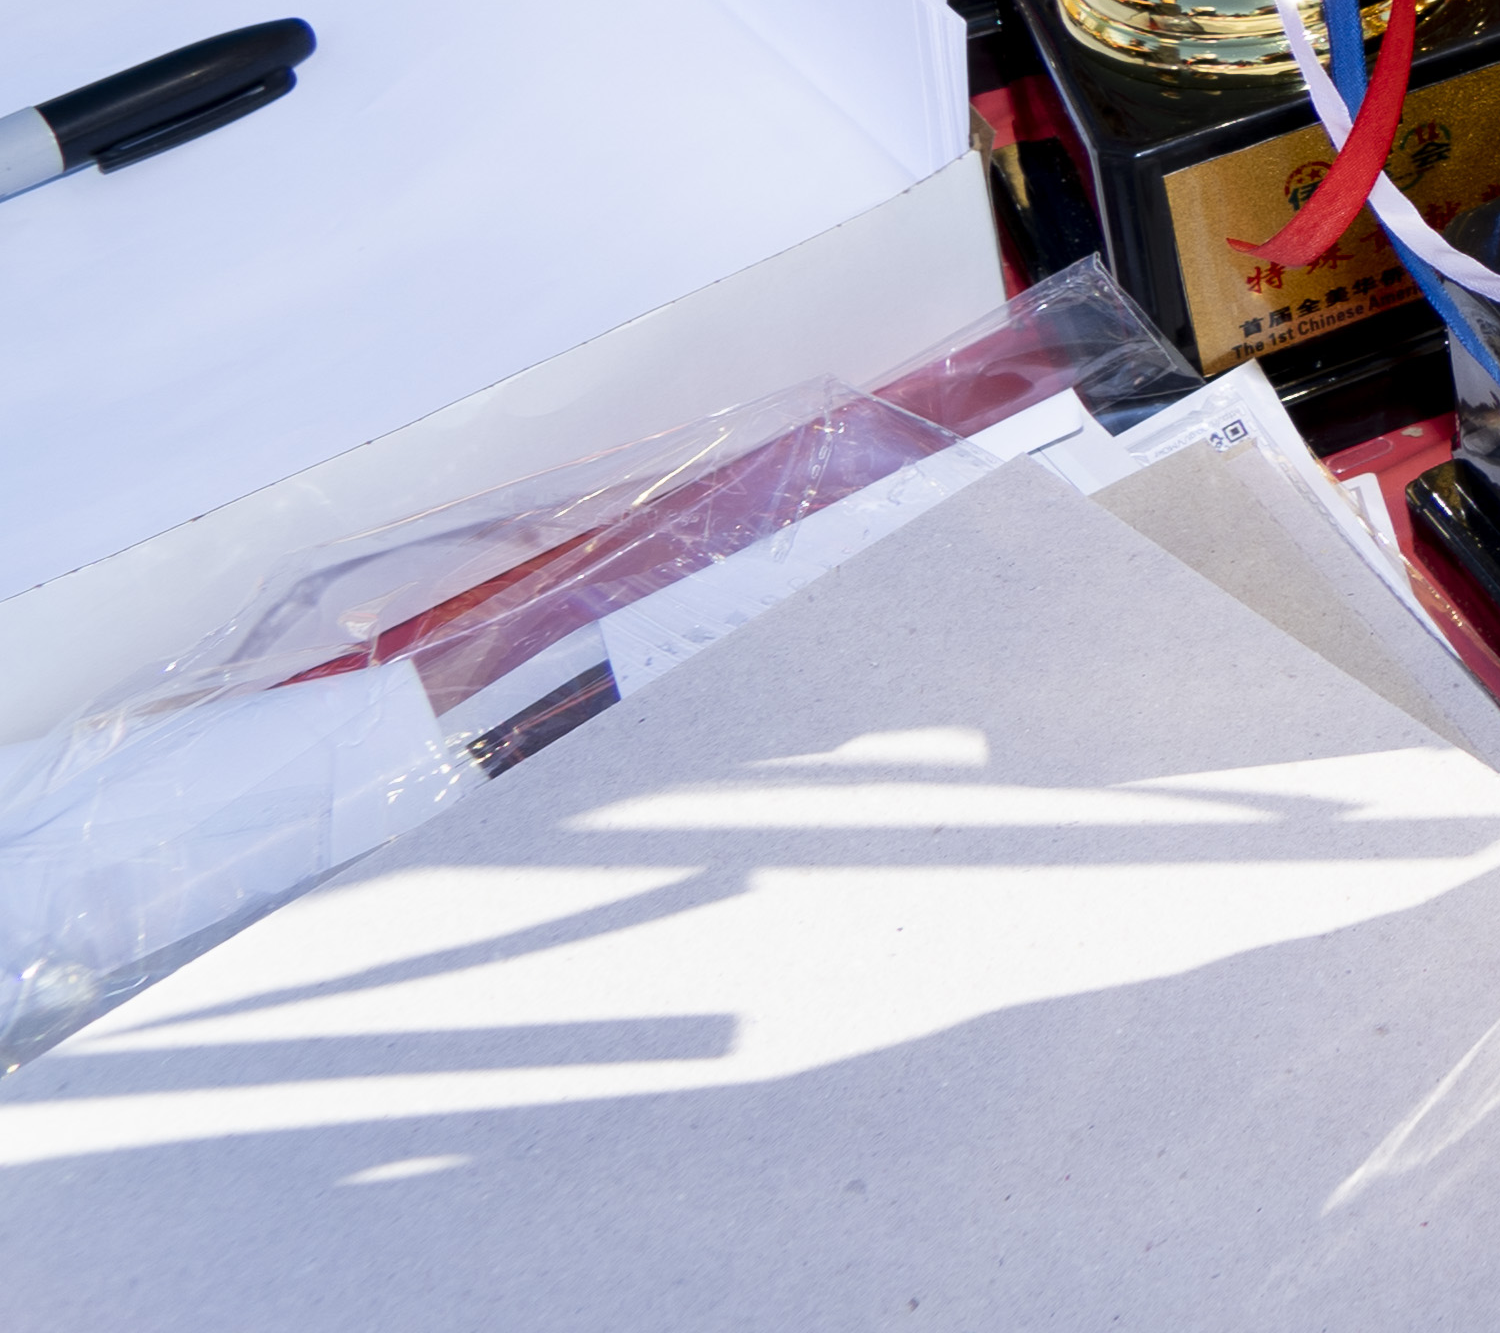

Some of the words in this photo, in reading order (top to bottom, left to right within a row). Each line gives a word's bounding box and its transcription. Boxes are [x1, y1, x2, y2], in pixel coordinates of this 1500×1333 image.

[1232, 341, 1265, 360] The
[1268, 327, 1295, 346] 1st
[1298, 302, 1365, 335] Chinese
[1368, 286, 1421, 311] Ameri
